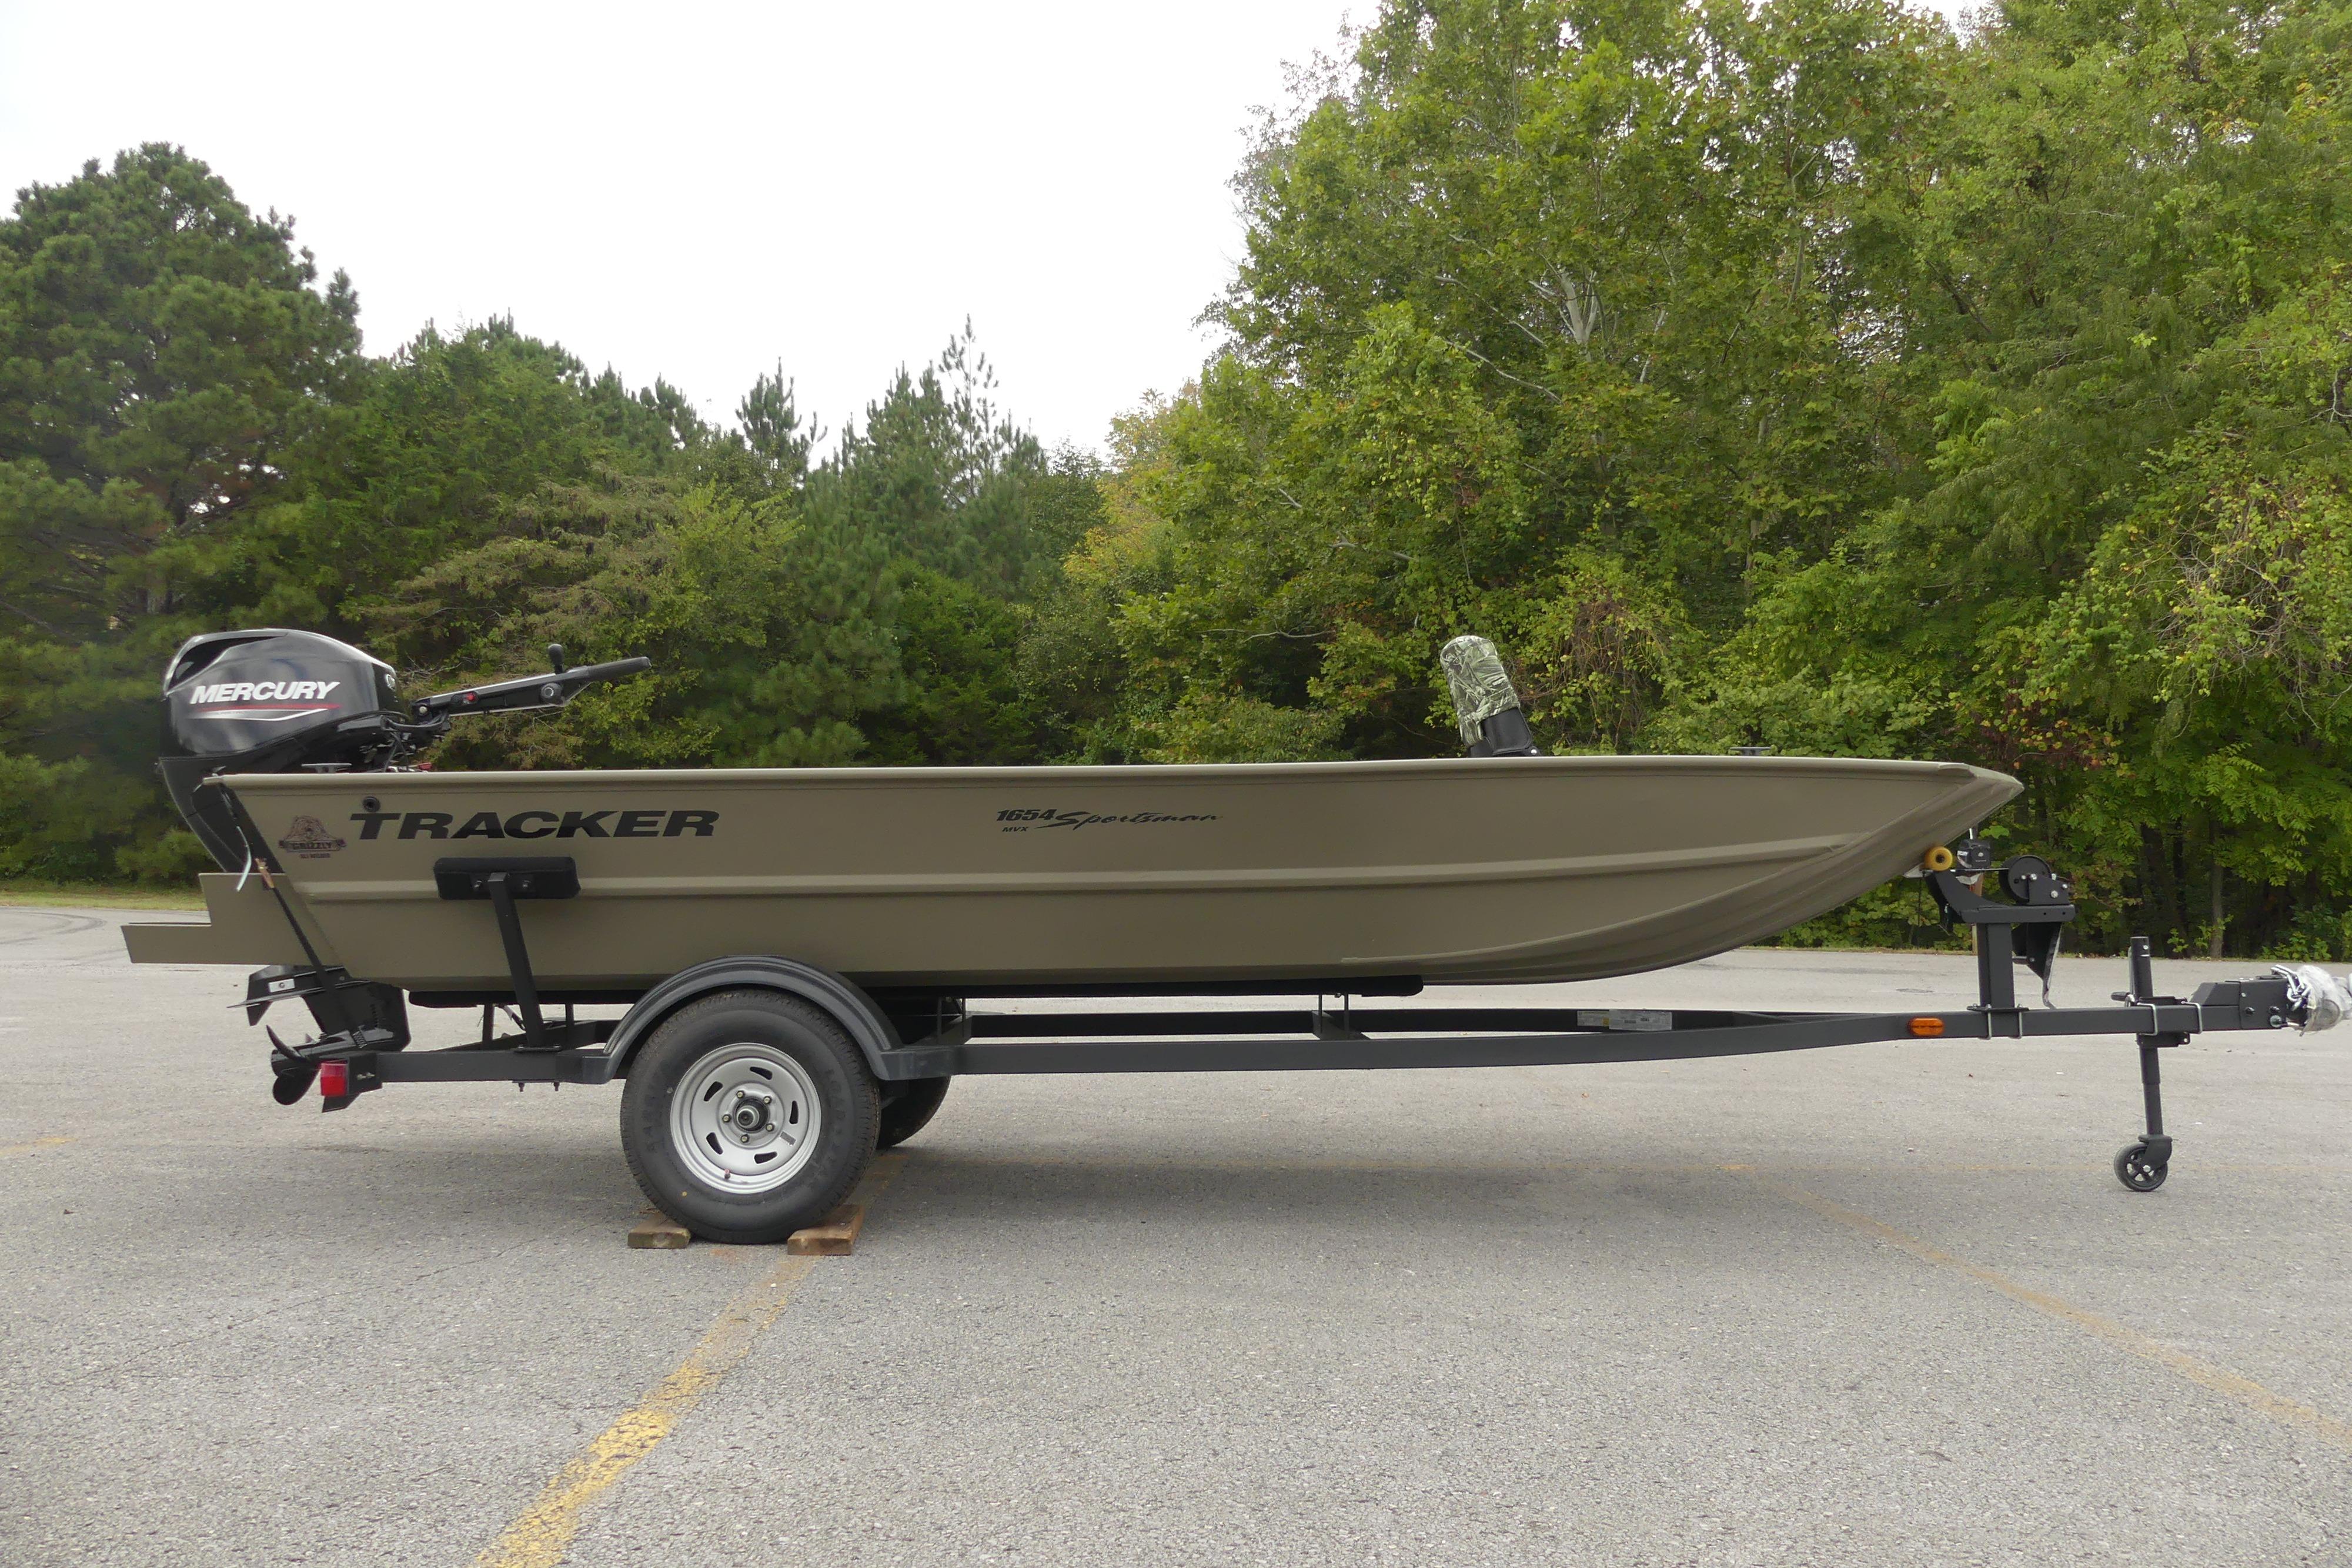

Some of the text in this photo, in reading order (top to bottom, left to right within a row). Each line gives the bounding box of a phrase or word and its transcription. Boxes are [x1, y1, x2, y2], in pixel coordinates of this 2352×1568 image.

[190, 681, 340, 704] MERCURY
[350, 810, 719, 840] TRACKER
[997, 808, 1222, 831] 1654 Sportsman
